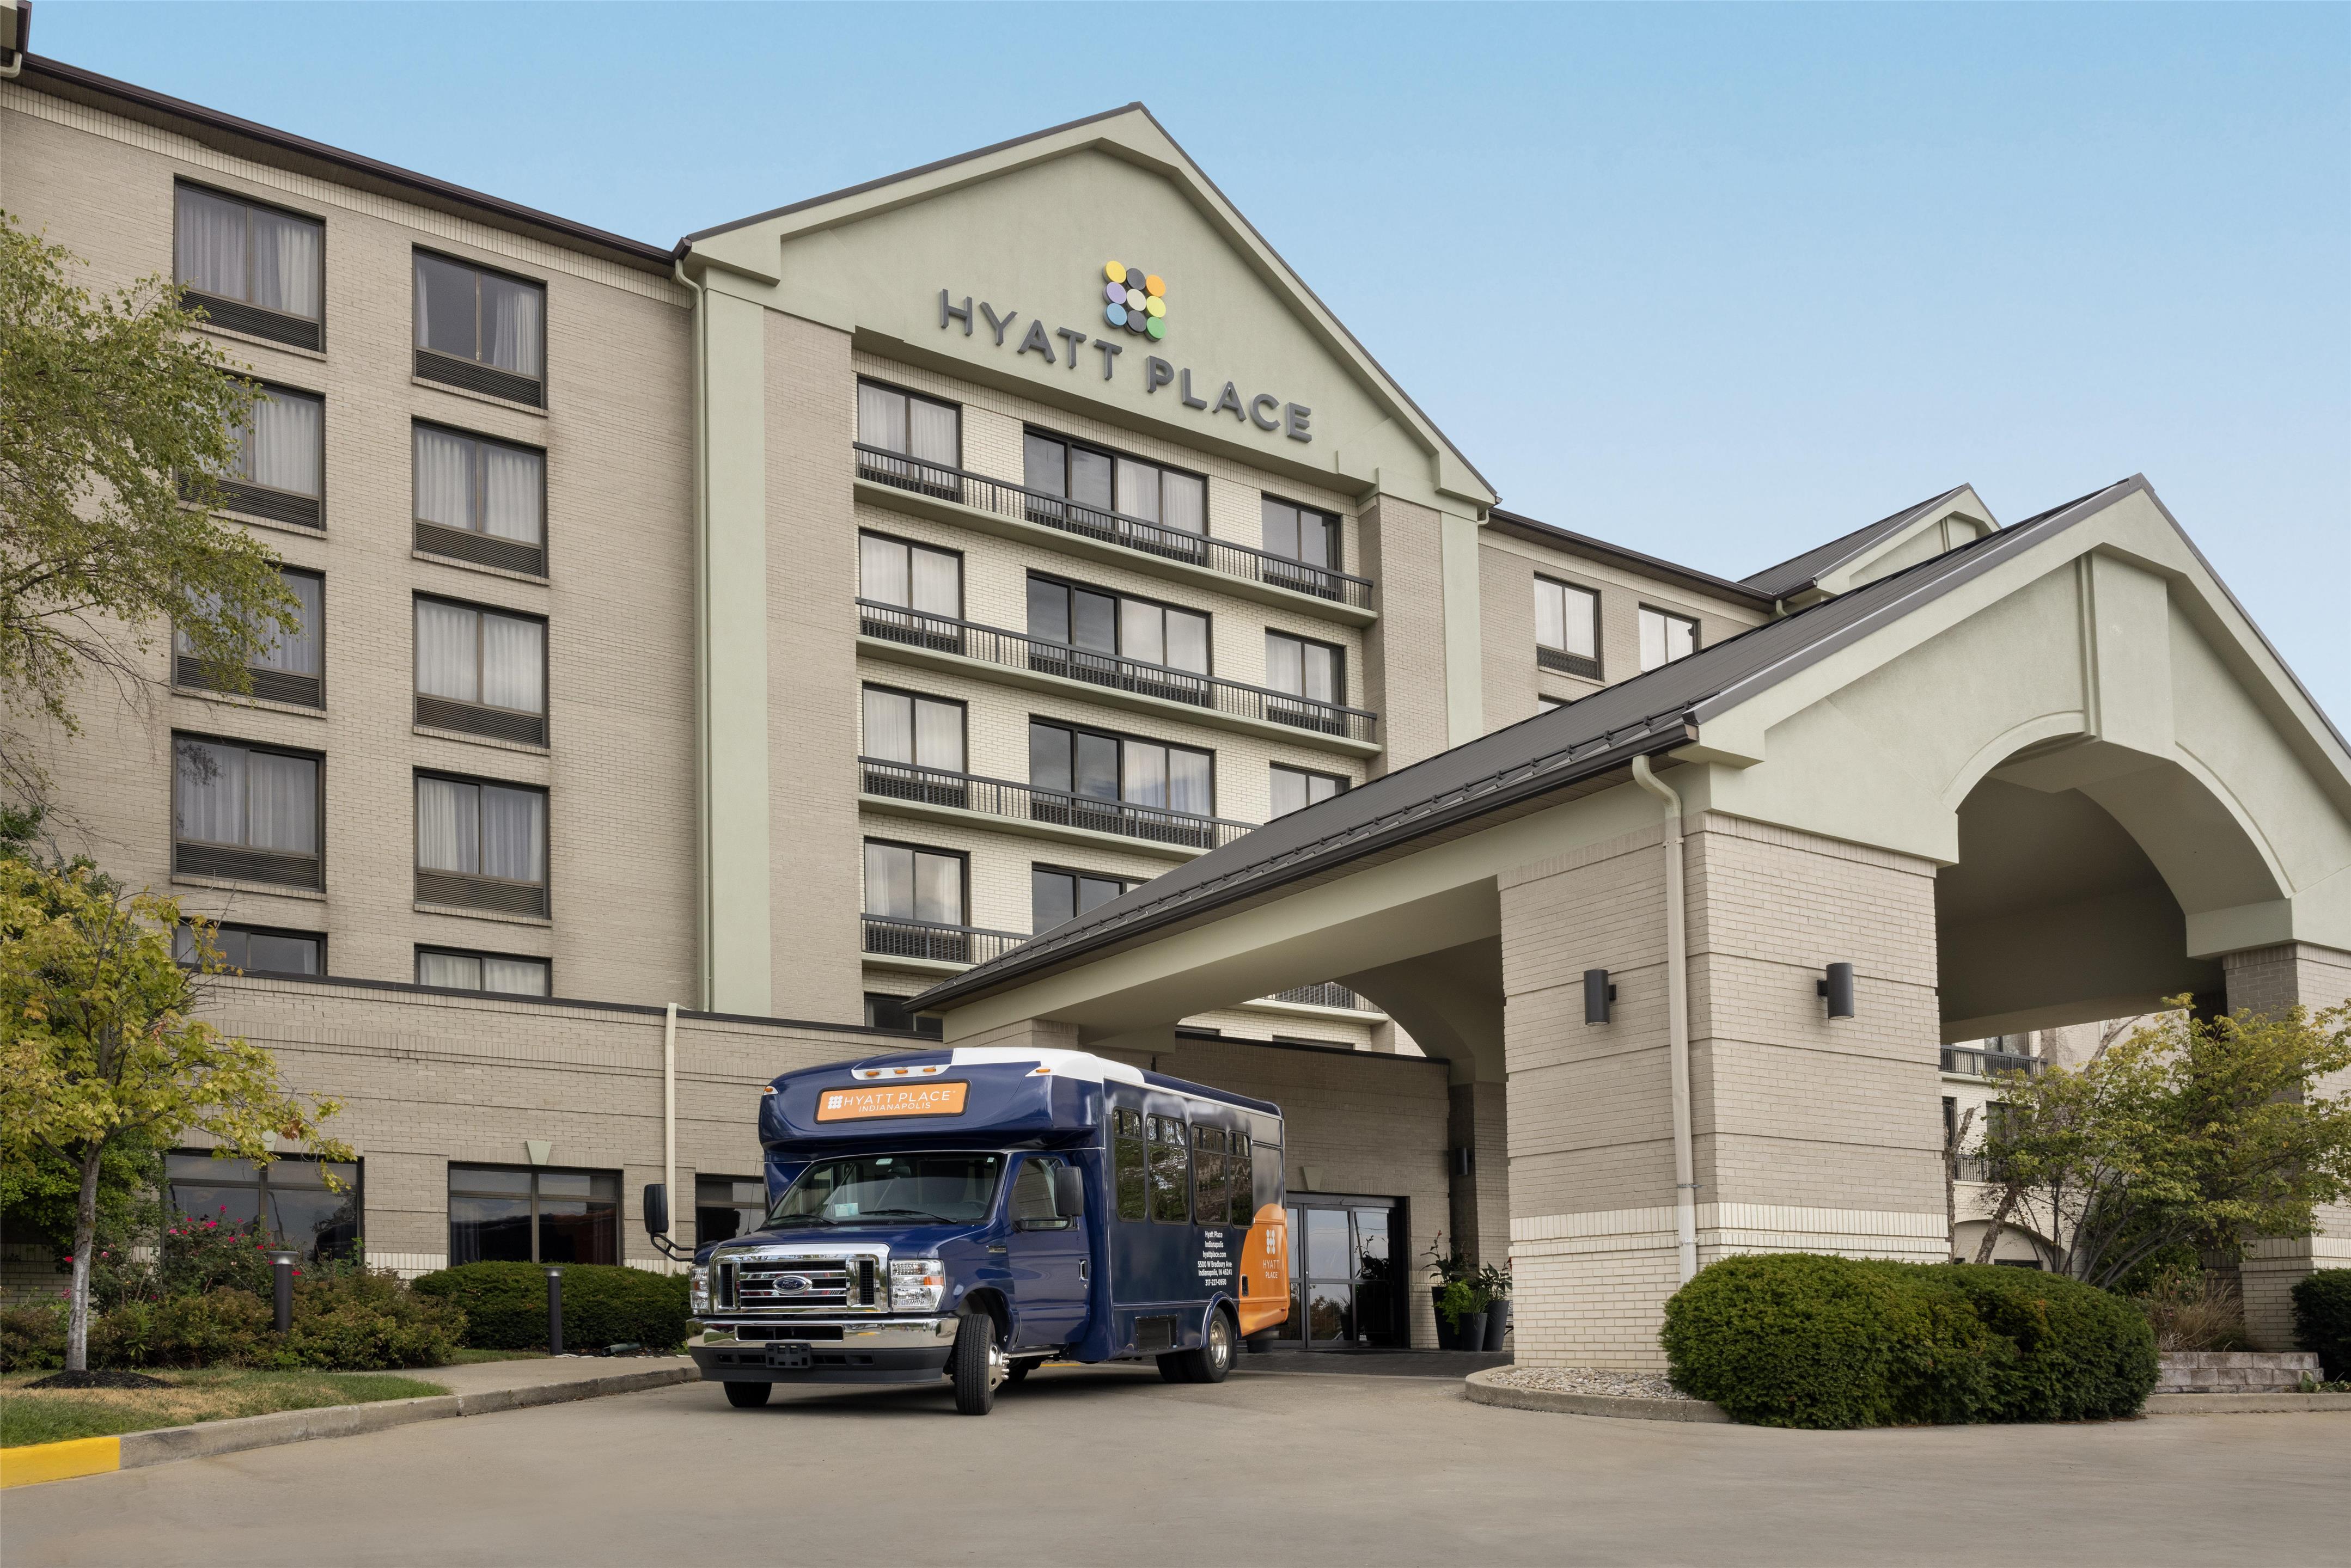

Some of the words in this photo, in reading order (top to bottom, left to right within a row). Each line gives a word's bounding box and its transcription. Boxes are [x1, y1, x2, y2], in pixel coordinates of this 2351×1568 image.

[939, 288, 1122, 381] HYATT
[1146, 355, 1312, 443] PLACE
[844, 1093, 894, 1106] HYATT
[899, 1091, 951, 1102] PLACE
[859, 1102, 931, 1112] INDIANAPOLIS
[1205, 1230, 1213, 1239] Hyatt
[1205, 1241, 1224, 1249] Indianapolis
[1202, 1251, 1226, 1259] hyattplace.com
[1211, 1260, 1225, 1269] Bradbury
[1263, 1259, 1279, 1269] HYATT
[1198, 1269, 1219, 1277] Indianapolis,
[781, 1279, 798, 1288] Ford
